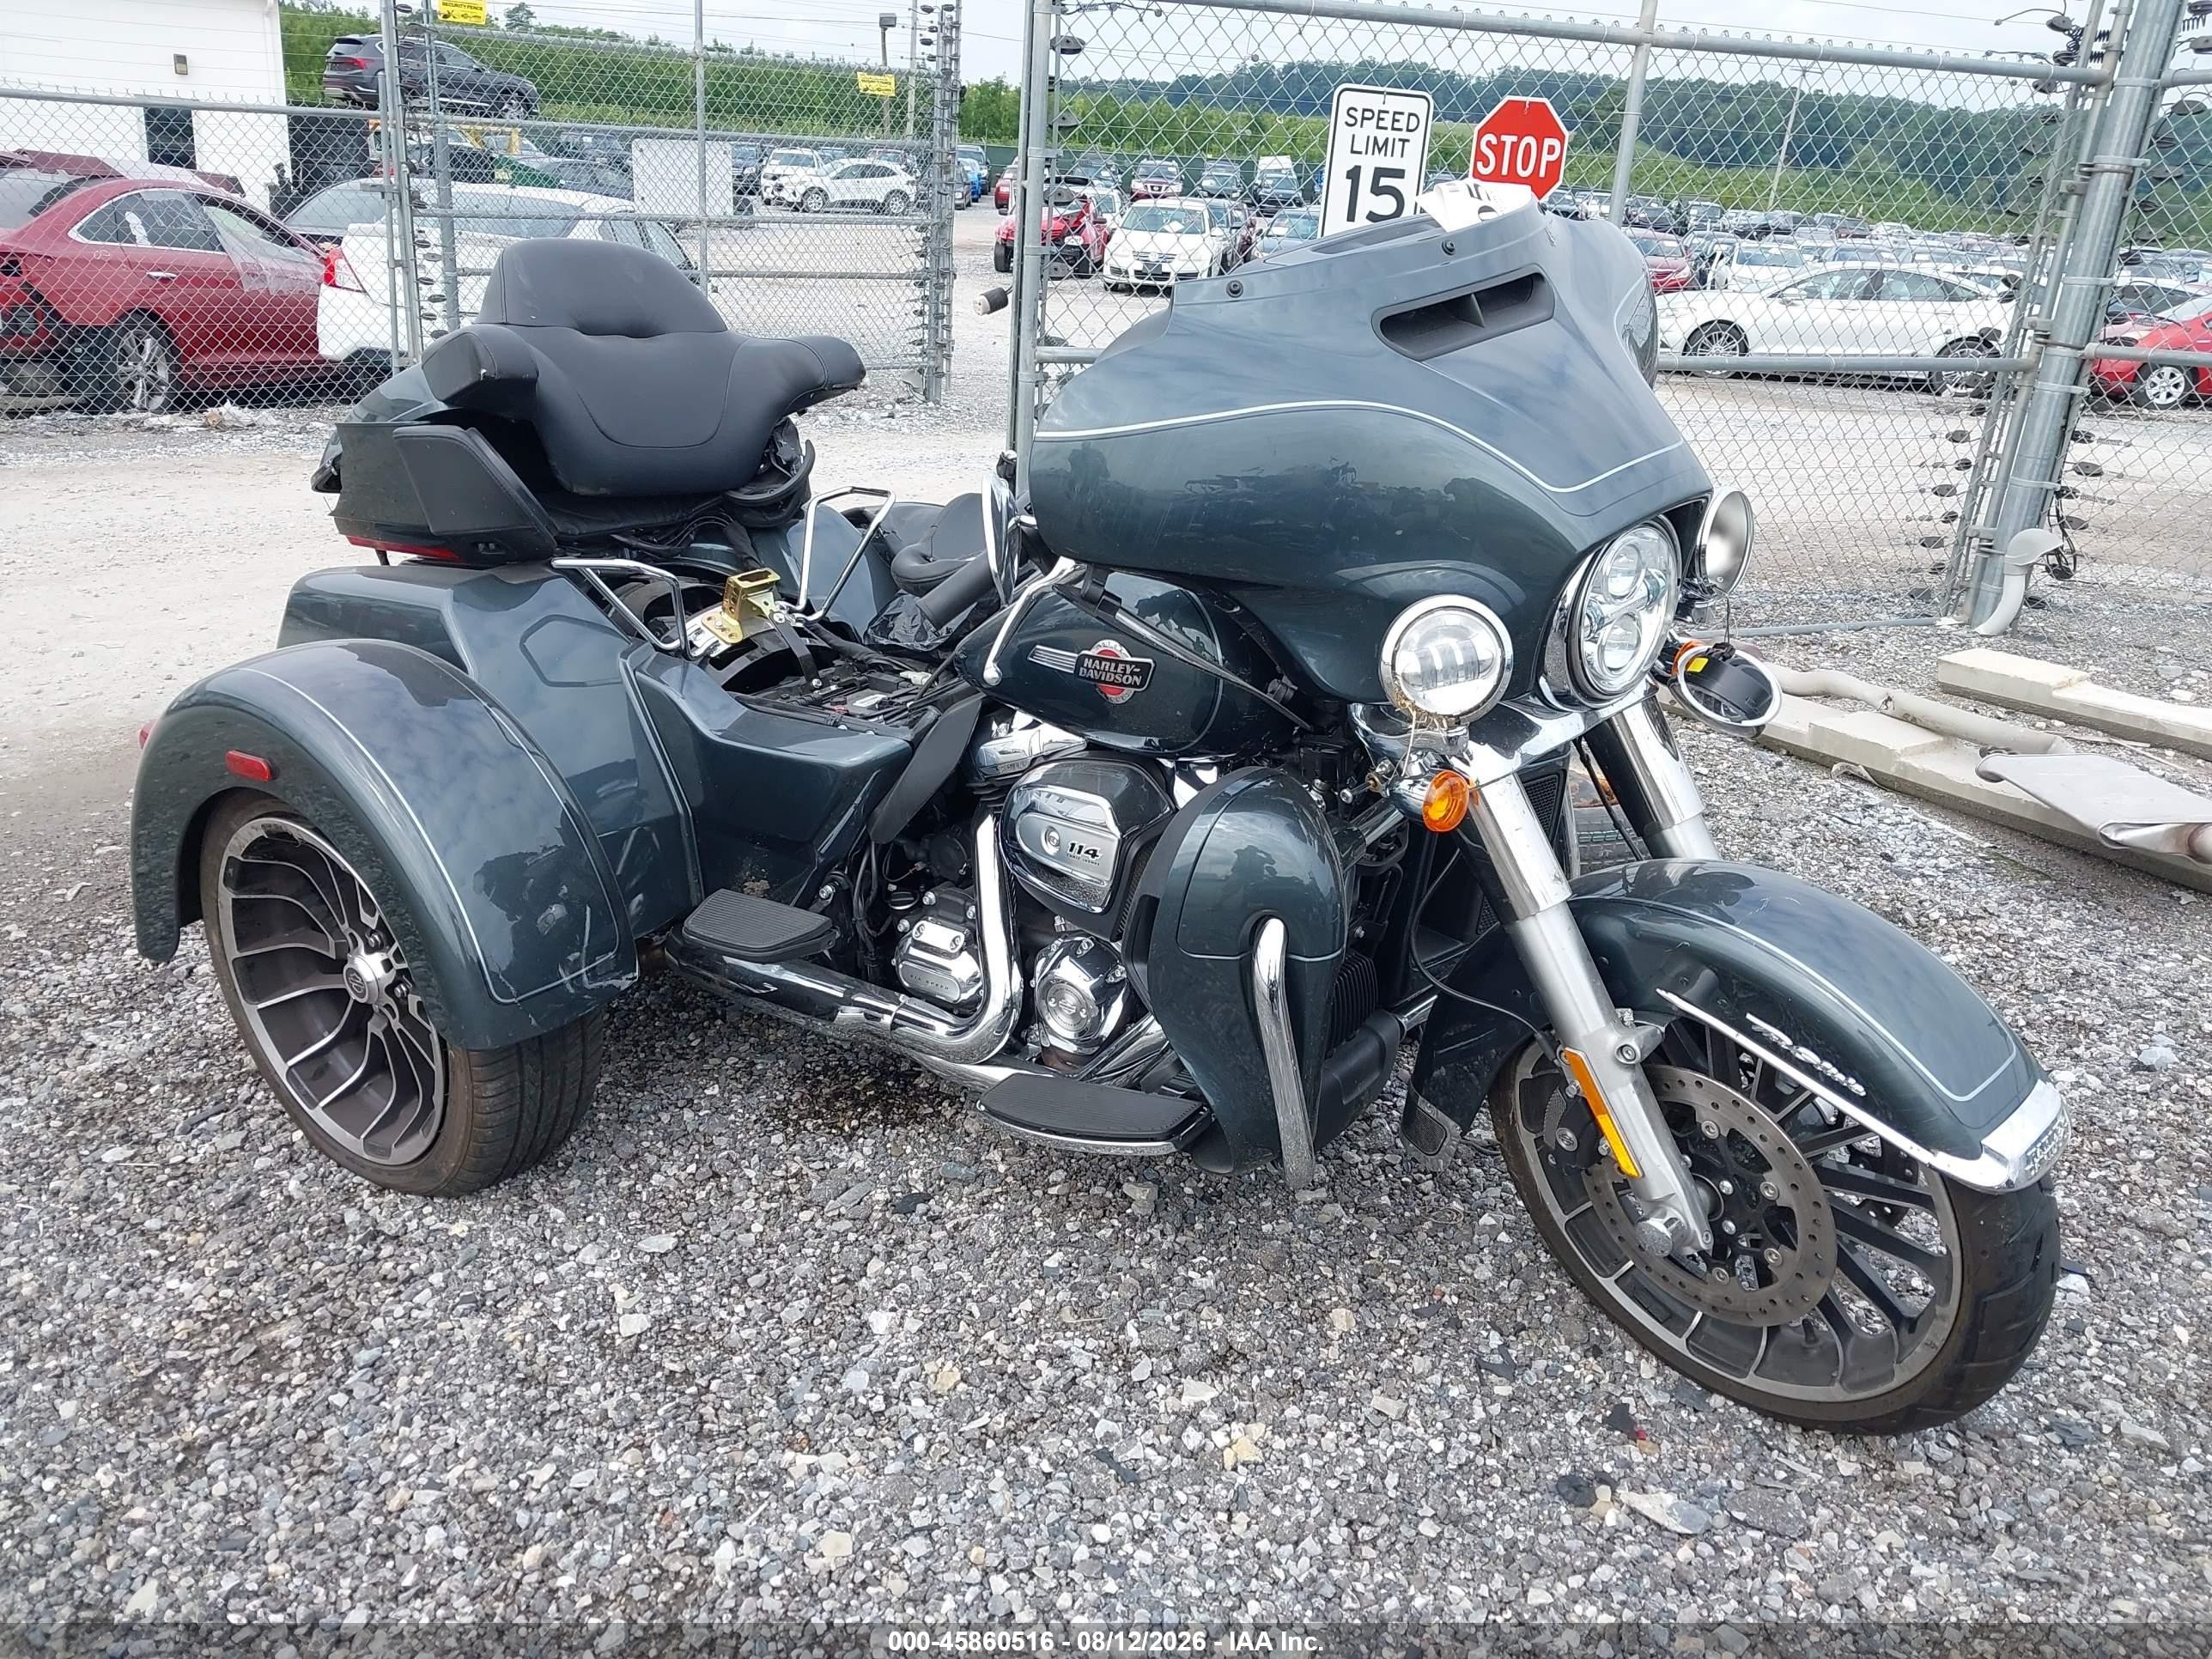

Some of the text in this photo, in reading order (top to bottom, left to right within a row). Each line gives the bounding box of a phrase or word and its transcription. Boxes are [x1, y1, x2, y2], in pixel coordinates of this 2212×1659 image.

[1345, 106, 1420, 133] SPEED
[1350, 133, 1410, 159] LIMIT
[1476, 132, 1562, 179] STOP
[1345, 164, 1406, 223] 15
[1079, 667, 1142, 685] DAVIDSON
[1083, 658, 1140, 674] HARLEY-
[1069, 842, 1100, 859] 114
